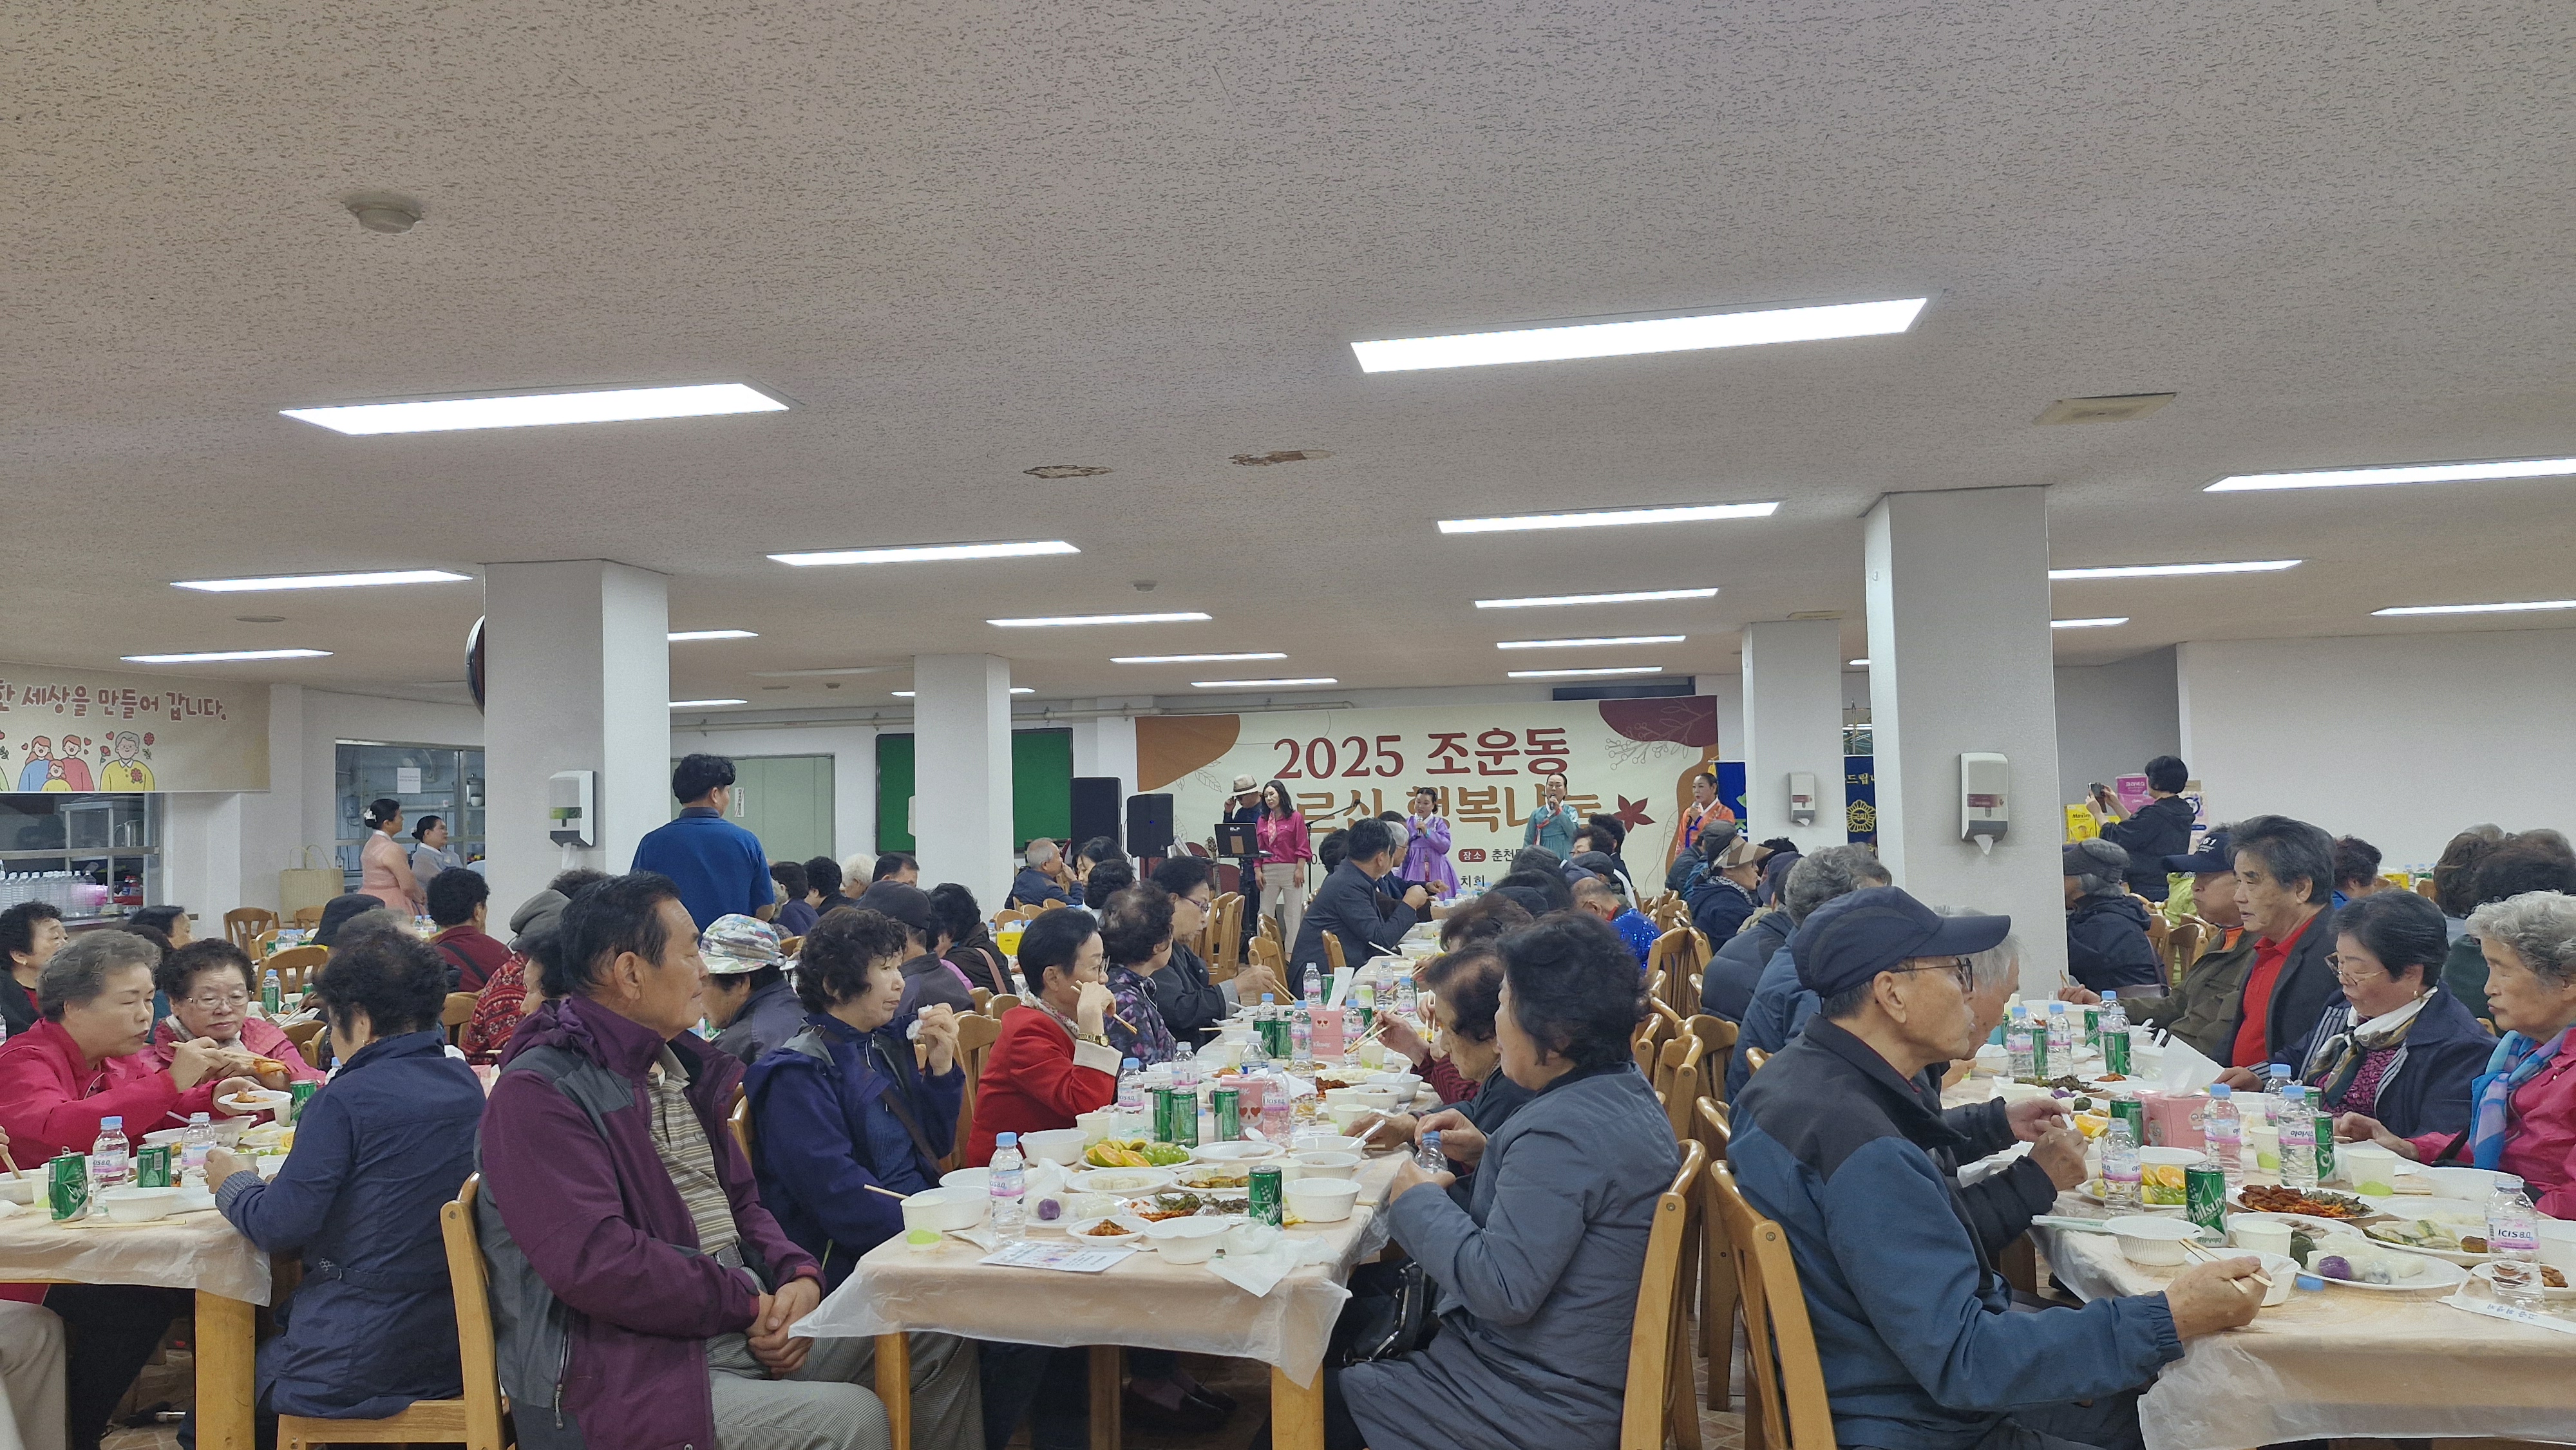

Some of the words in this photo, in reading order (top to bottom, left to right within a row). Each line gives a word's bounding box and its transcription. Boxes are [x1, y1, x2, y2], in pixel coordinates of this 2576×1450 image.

[21, 684, 91, 717] 세상을
[97, 688, 160, 720] 만들어
[166, 691, 227, 721] 갑니다.
[1273, 735, 1405, 779] 2025
[1426, 727, 1571, 775] 조운동
[1463, 851, 1482, 862] 장소
[1492, 849, 1522, 862] 춘천
[1460, 874, 1485, 888] 치회
[2498, 1229, 2518, 1238] ICIS
